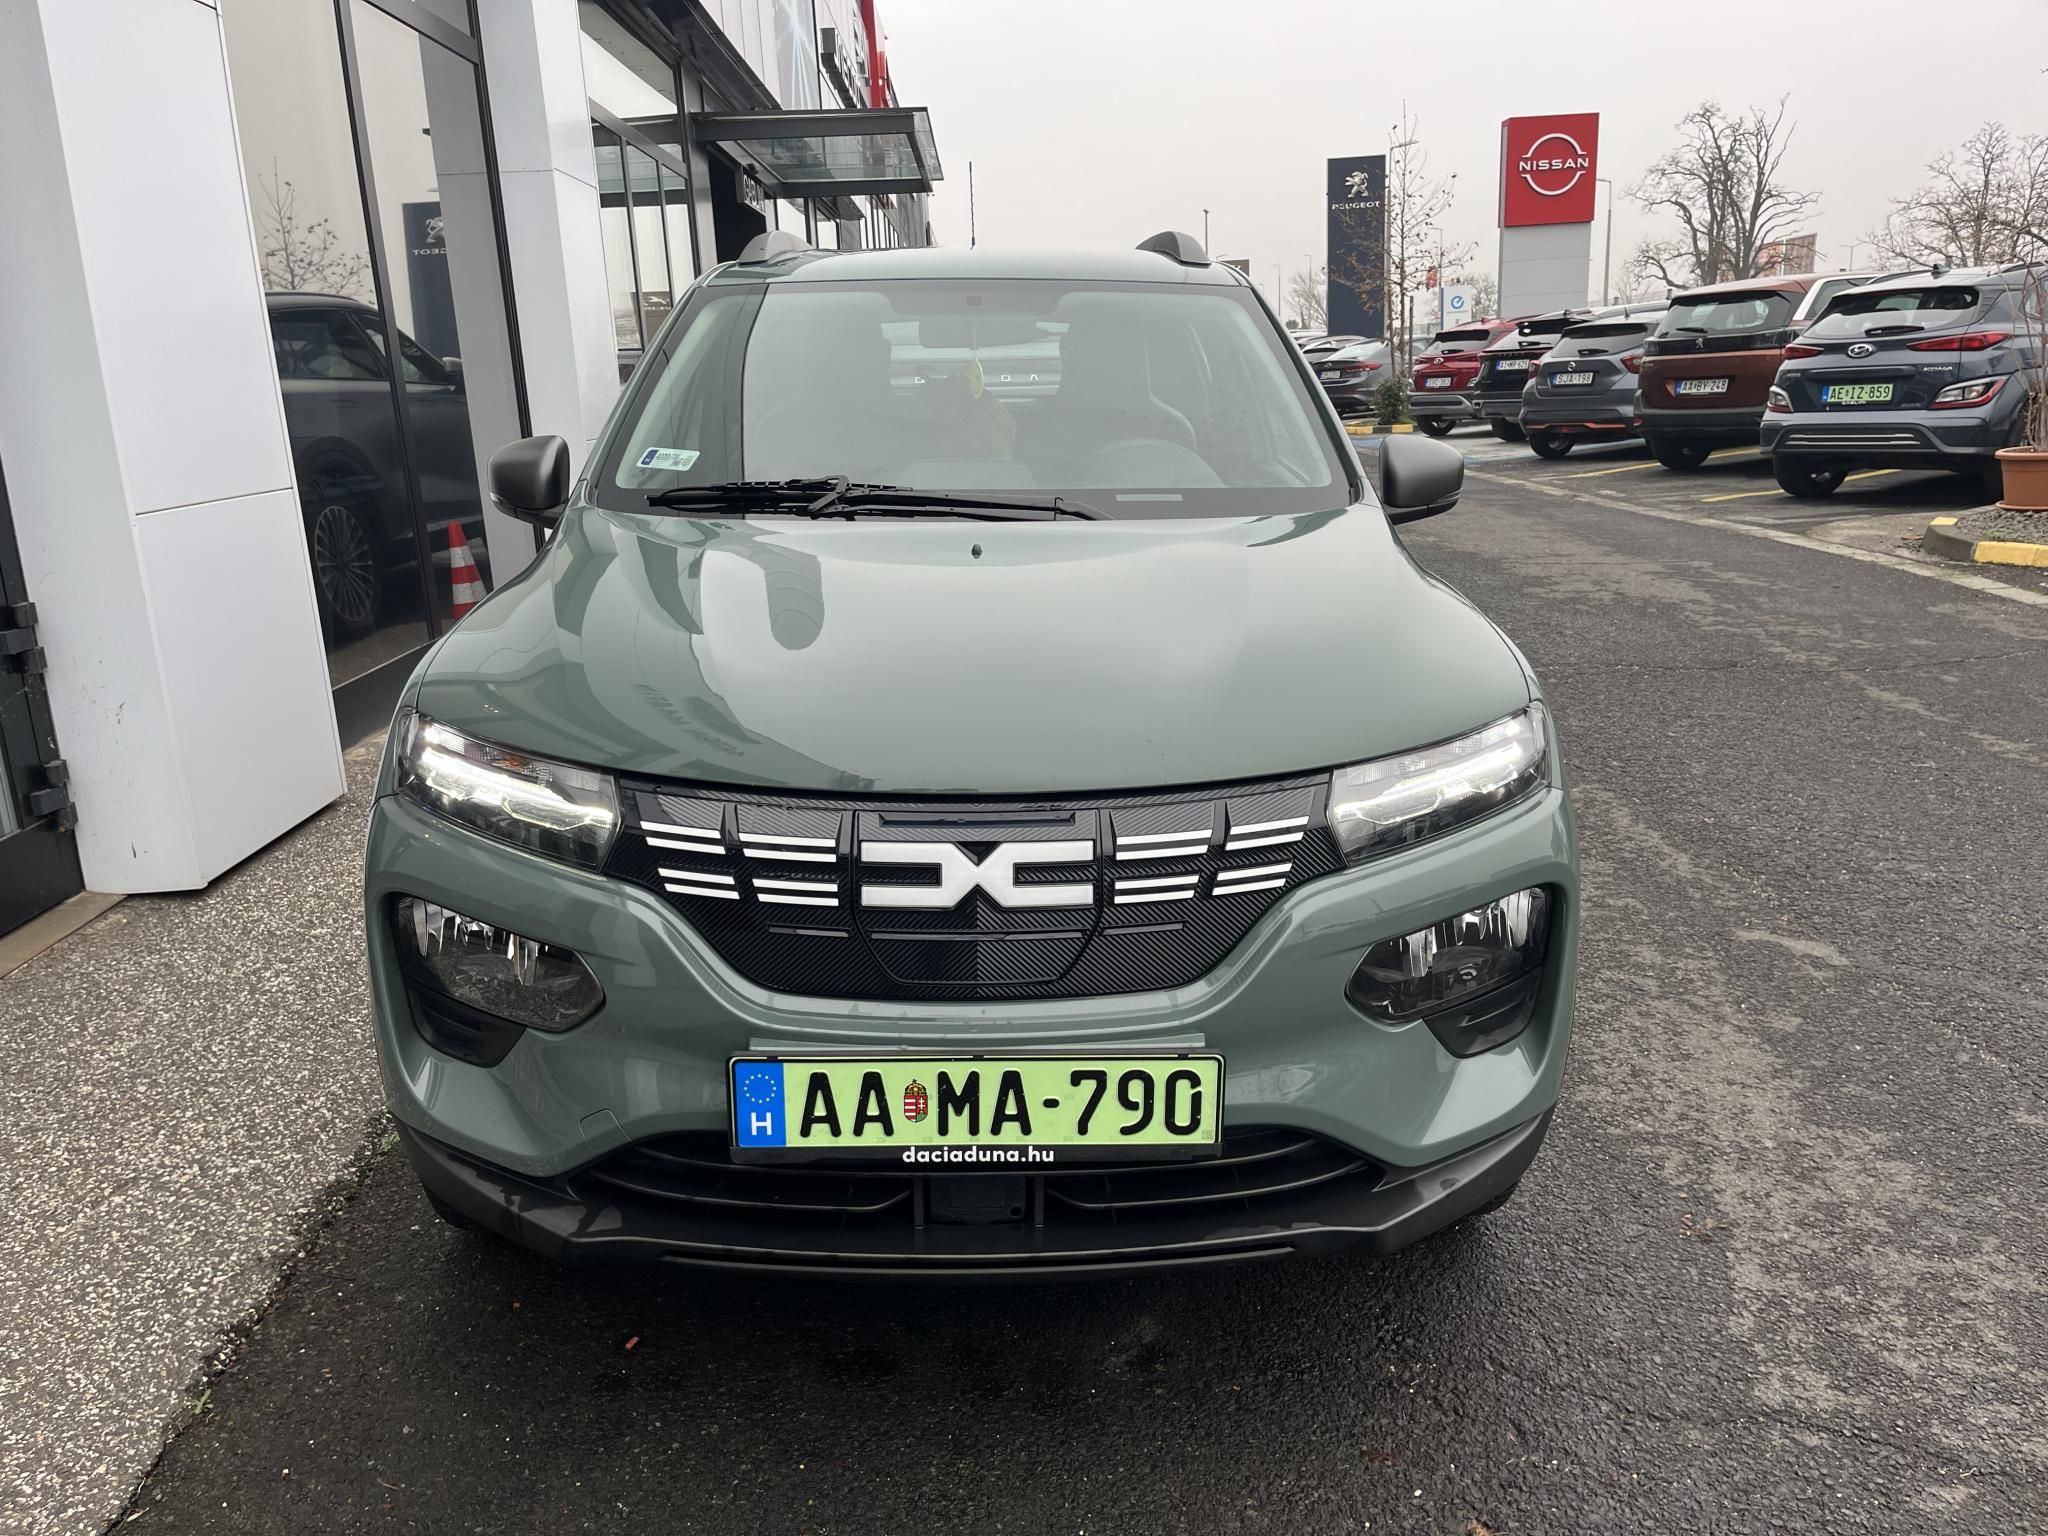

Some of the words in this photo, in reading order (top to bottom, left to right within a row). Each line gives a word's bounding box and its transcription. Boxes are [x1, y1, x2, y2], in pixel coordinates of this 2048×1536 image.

[1518, 157, 1590, 172] NISSAN
[1331, 200, 1381, 211] PEUGEOT
[750, 1112, 773, 1136] H
[902, 1146, 1055, 1164] daciaduna.hu
